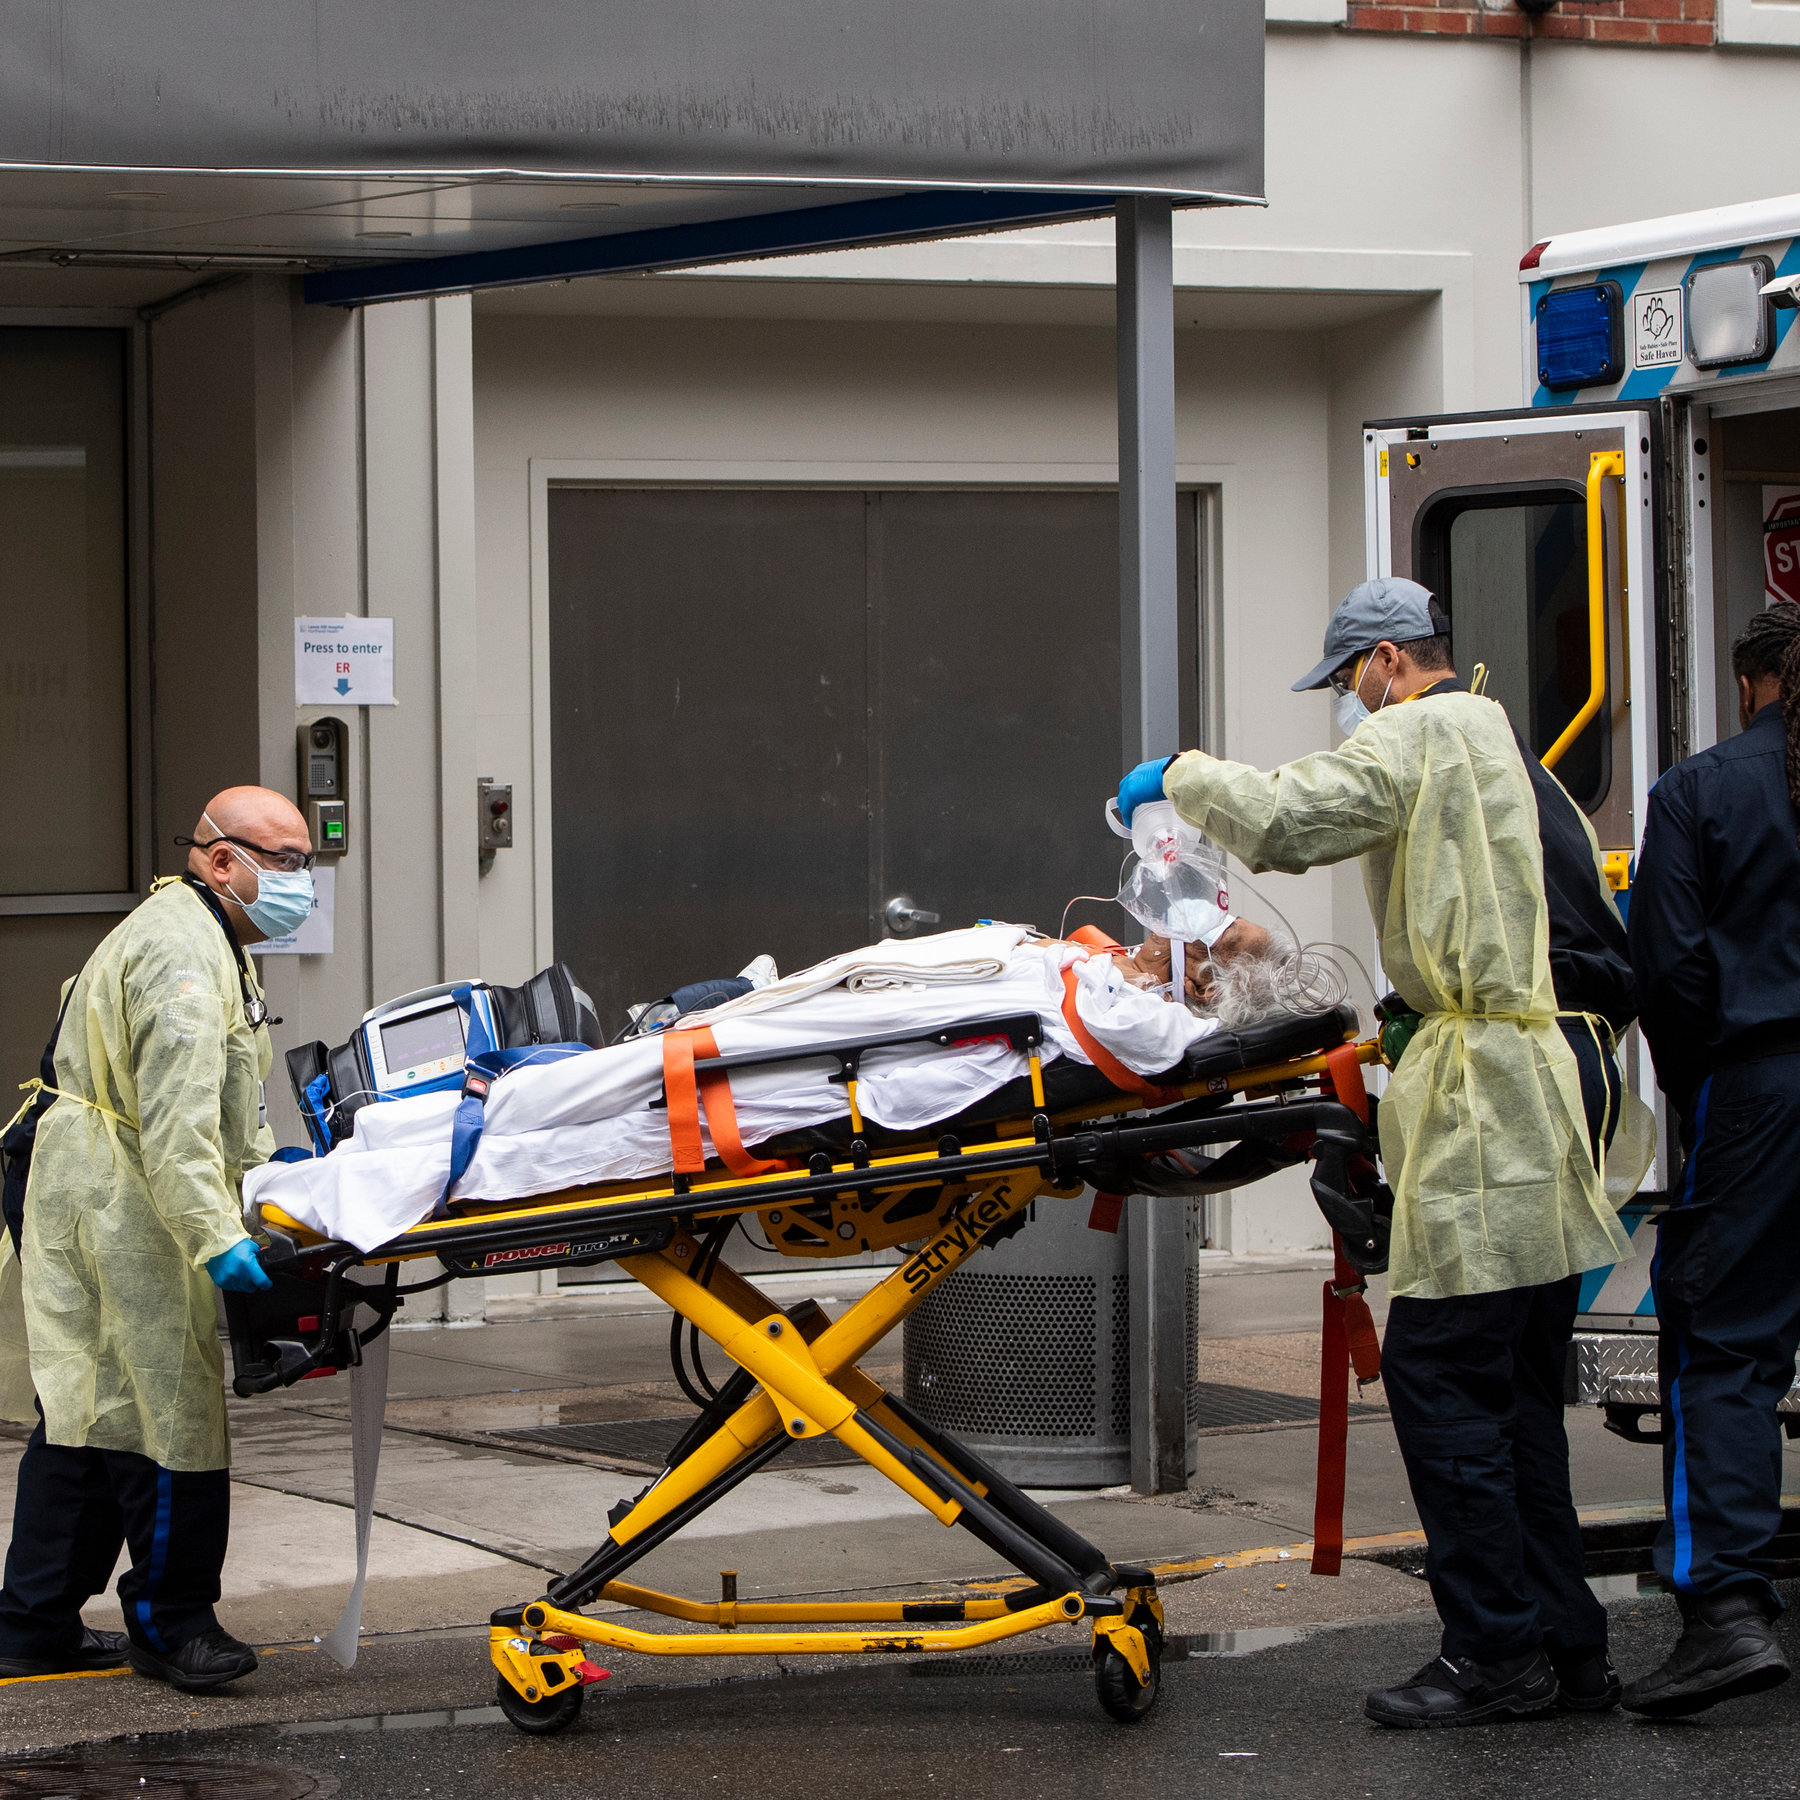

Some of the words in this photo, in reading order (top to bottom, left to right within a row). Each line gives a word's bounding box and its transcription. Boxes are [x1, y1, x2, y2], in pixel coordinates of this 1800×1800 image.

[1640, 351, 1655, 362] Safe
[1656, 349, 1677, 360] Haven
[1768, 517, 1800, 531] IMPORTAN
[304, 641, 334, 653] Press
[336, 643, 349, 653] to
[352, 643, 383, 654] enter
[336, 662, 351, 674] ER
[902, 1184, 1012, 1295] stryker
[484, 1241, 571, 1268] power
[571, 1241, 609, 1256] pro
[609, 1233, 630, 1243] XT
